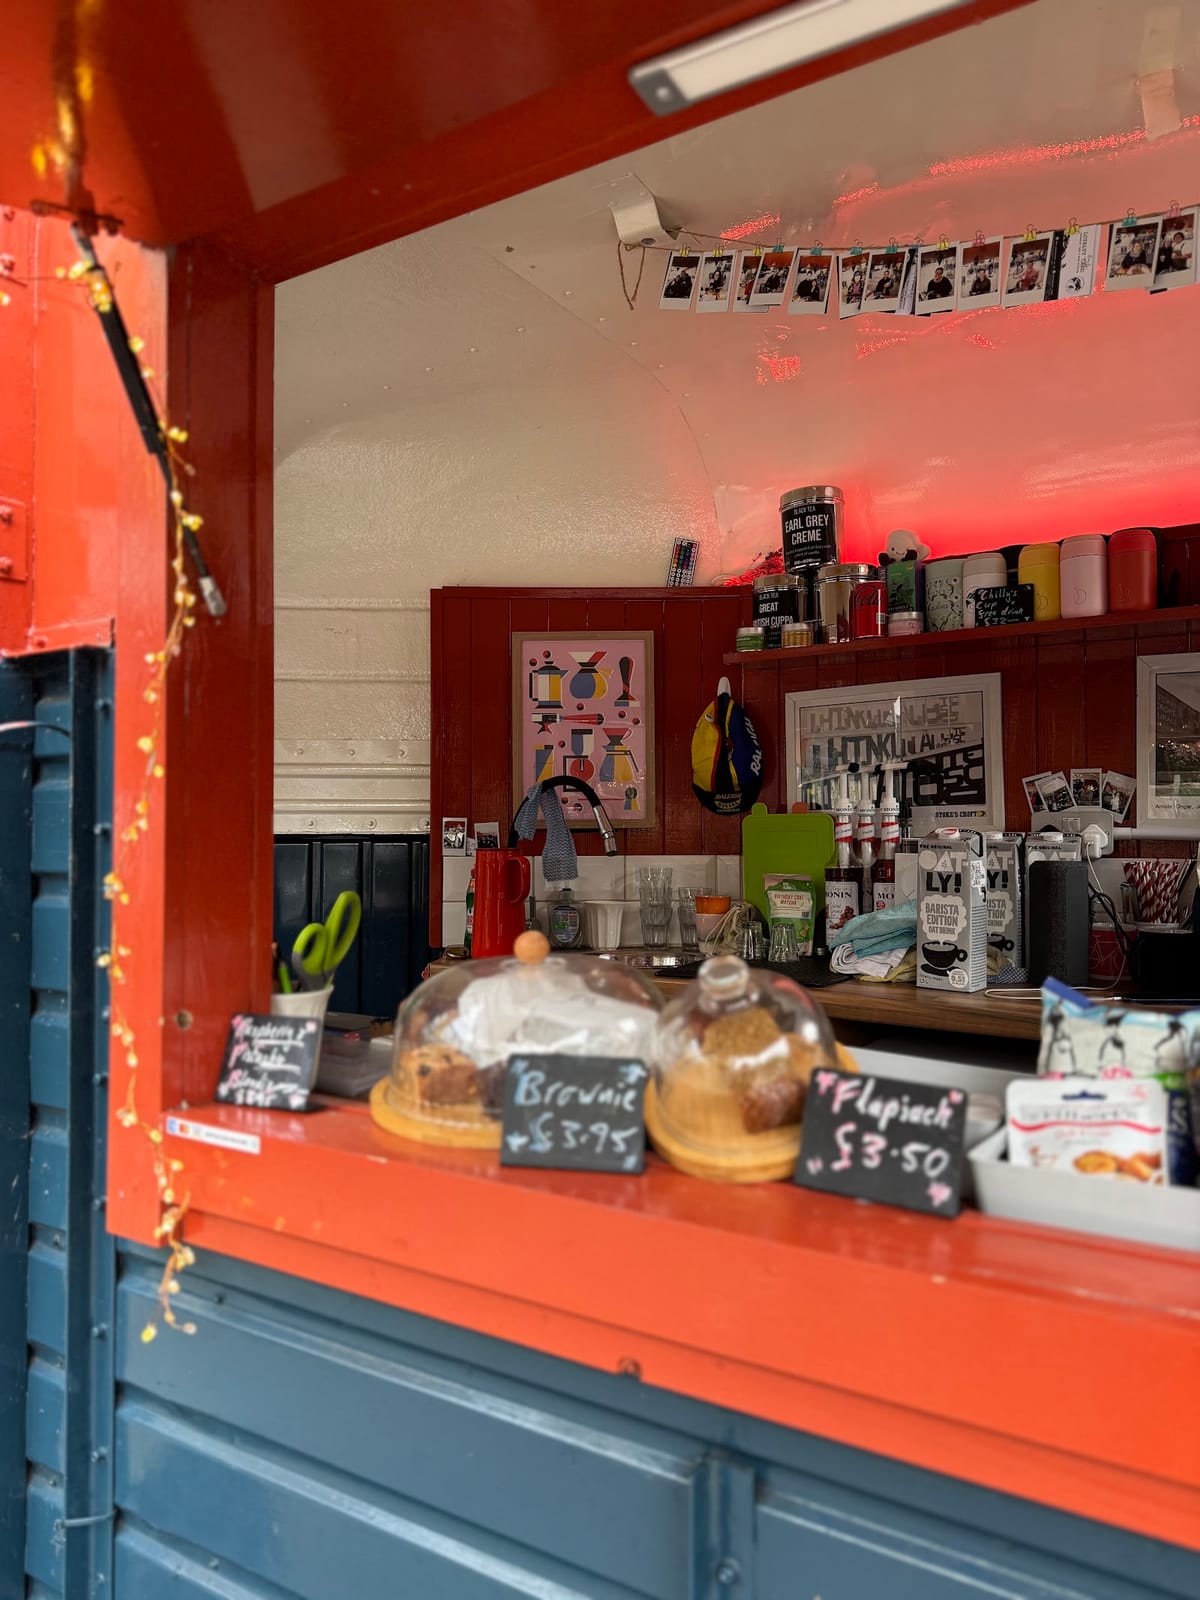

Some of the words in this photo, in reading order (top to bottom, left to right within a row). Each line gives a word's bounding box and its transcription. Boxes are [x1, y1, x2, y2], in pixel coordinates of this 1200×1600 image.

[785, 517, 804, 533] EARL
[805, 514, 830, 527] GREY
[791, 529, 822, 545] CREME
[979, 588, 1018, 603] Chilly's
[759, 602, 779, 613] GREAT
[1001, 606, 1024, 616] drink
[770, 616, 794, 627] CUPPA
[926, 872, 962, 893] LY!
[826, 891, 853, 899] ONIN
[925, 903, 960, 915] BARISTA
[926, 914, 959, 926] EDITION
[928, 925, 939, 934] OAT
[939, 926, 956, 935] DRINK
[514, 1070, 637, 1112] Brownie
[528, 1111, 639, 1153] £3.95
[832, 1122, 950, 1178] £3.50
